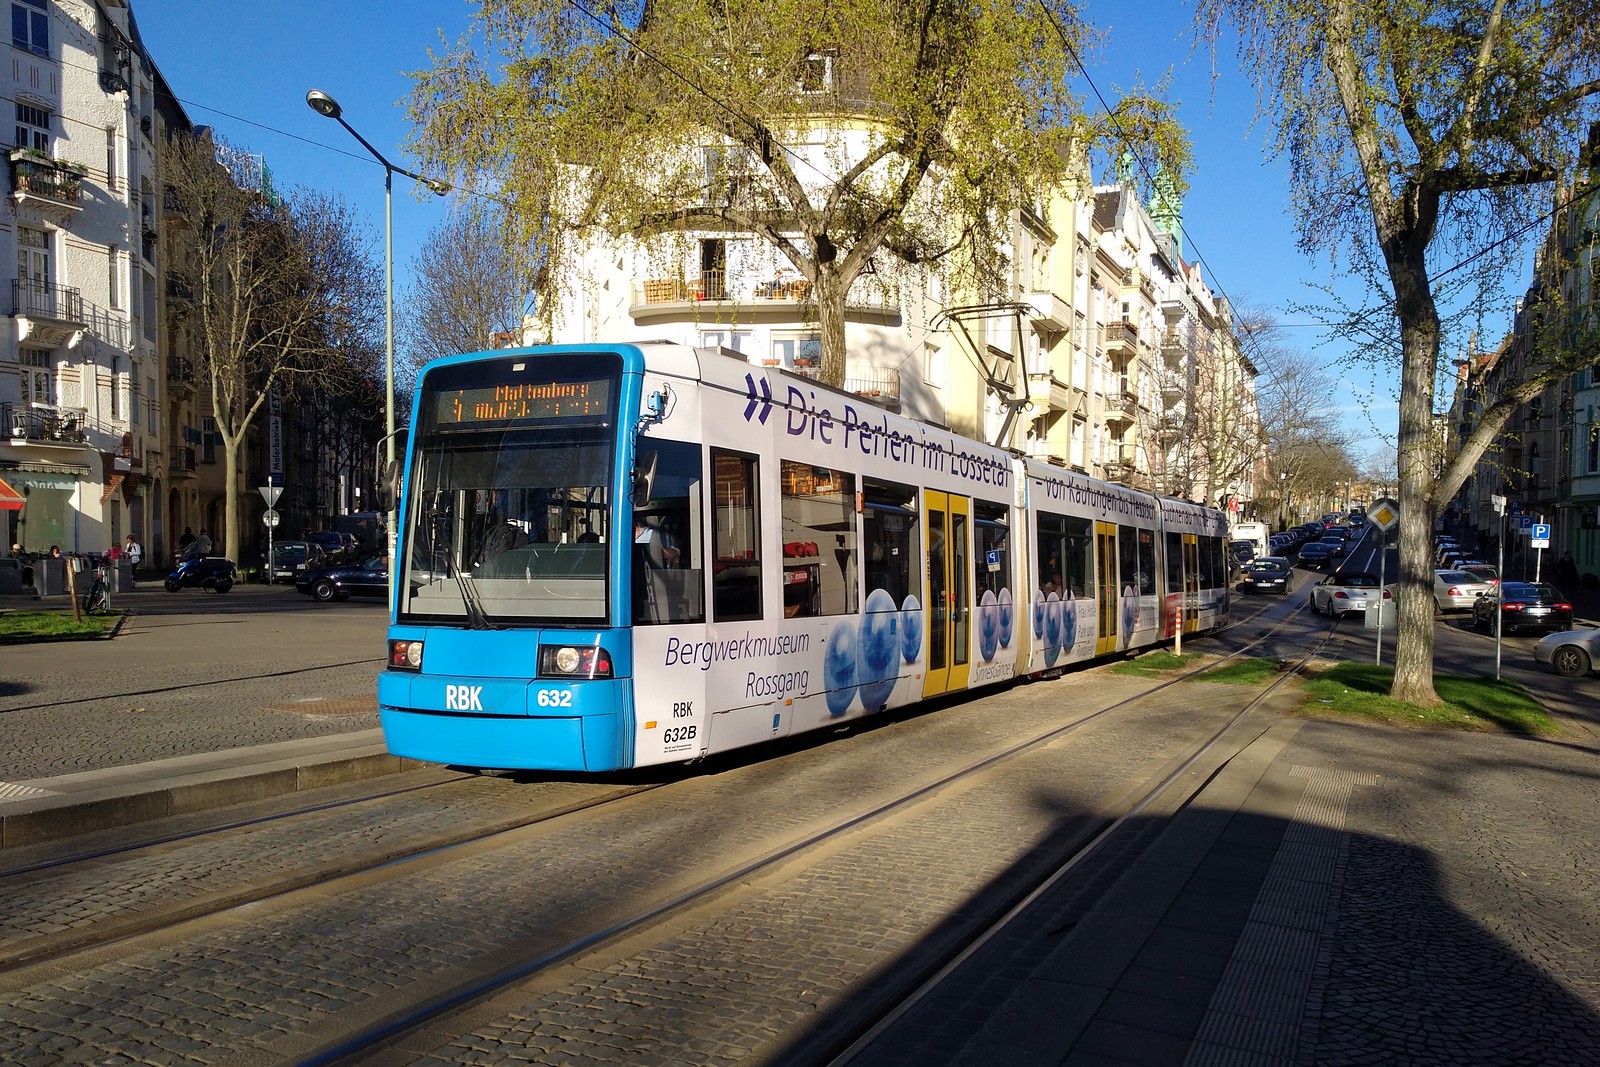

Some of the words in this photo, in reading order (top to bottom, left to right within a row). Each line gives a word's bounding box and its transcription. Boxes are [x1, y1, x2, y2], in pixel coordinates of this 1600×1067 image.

[272, 419, 281, 470] Malerbetrieb
[787, 385, 834, 444] Die
[845, 404, 915, 465] Perlen
[921, 428, 944, 473] im
[950, 439, 1009, 488] Lossetal
[1045, 476, 1066, 500] von
[1067, 476, 1118, 516] Kaufungen
[1118, 488, 1129, 514] bis
[1130, 493, 1156, 520] Hessisch
[1536, 526, 1546, 537] P
[665, 631, 809, 671] Bergwerkmuseum
[446, 685, 483, 710] RBK
[537, 689, 572, 707] 632
[745, 670, 809, 700] Rossgang
[673, 701, 693, 718] RBK
[664, 725, 697, 743] 632B
